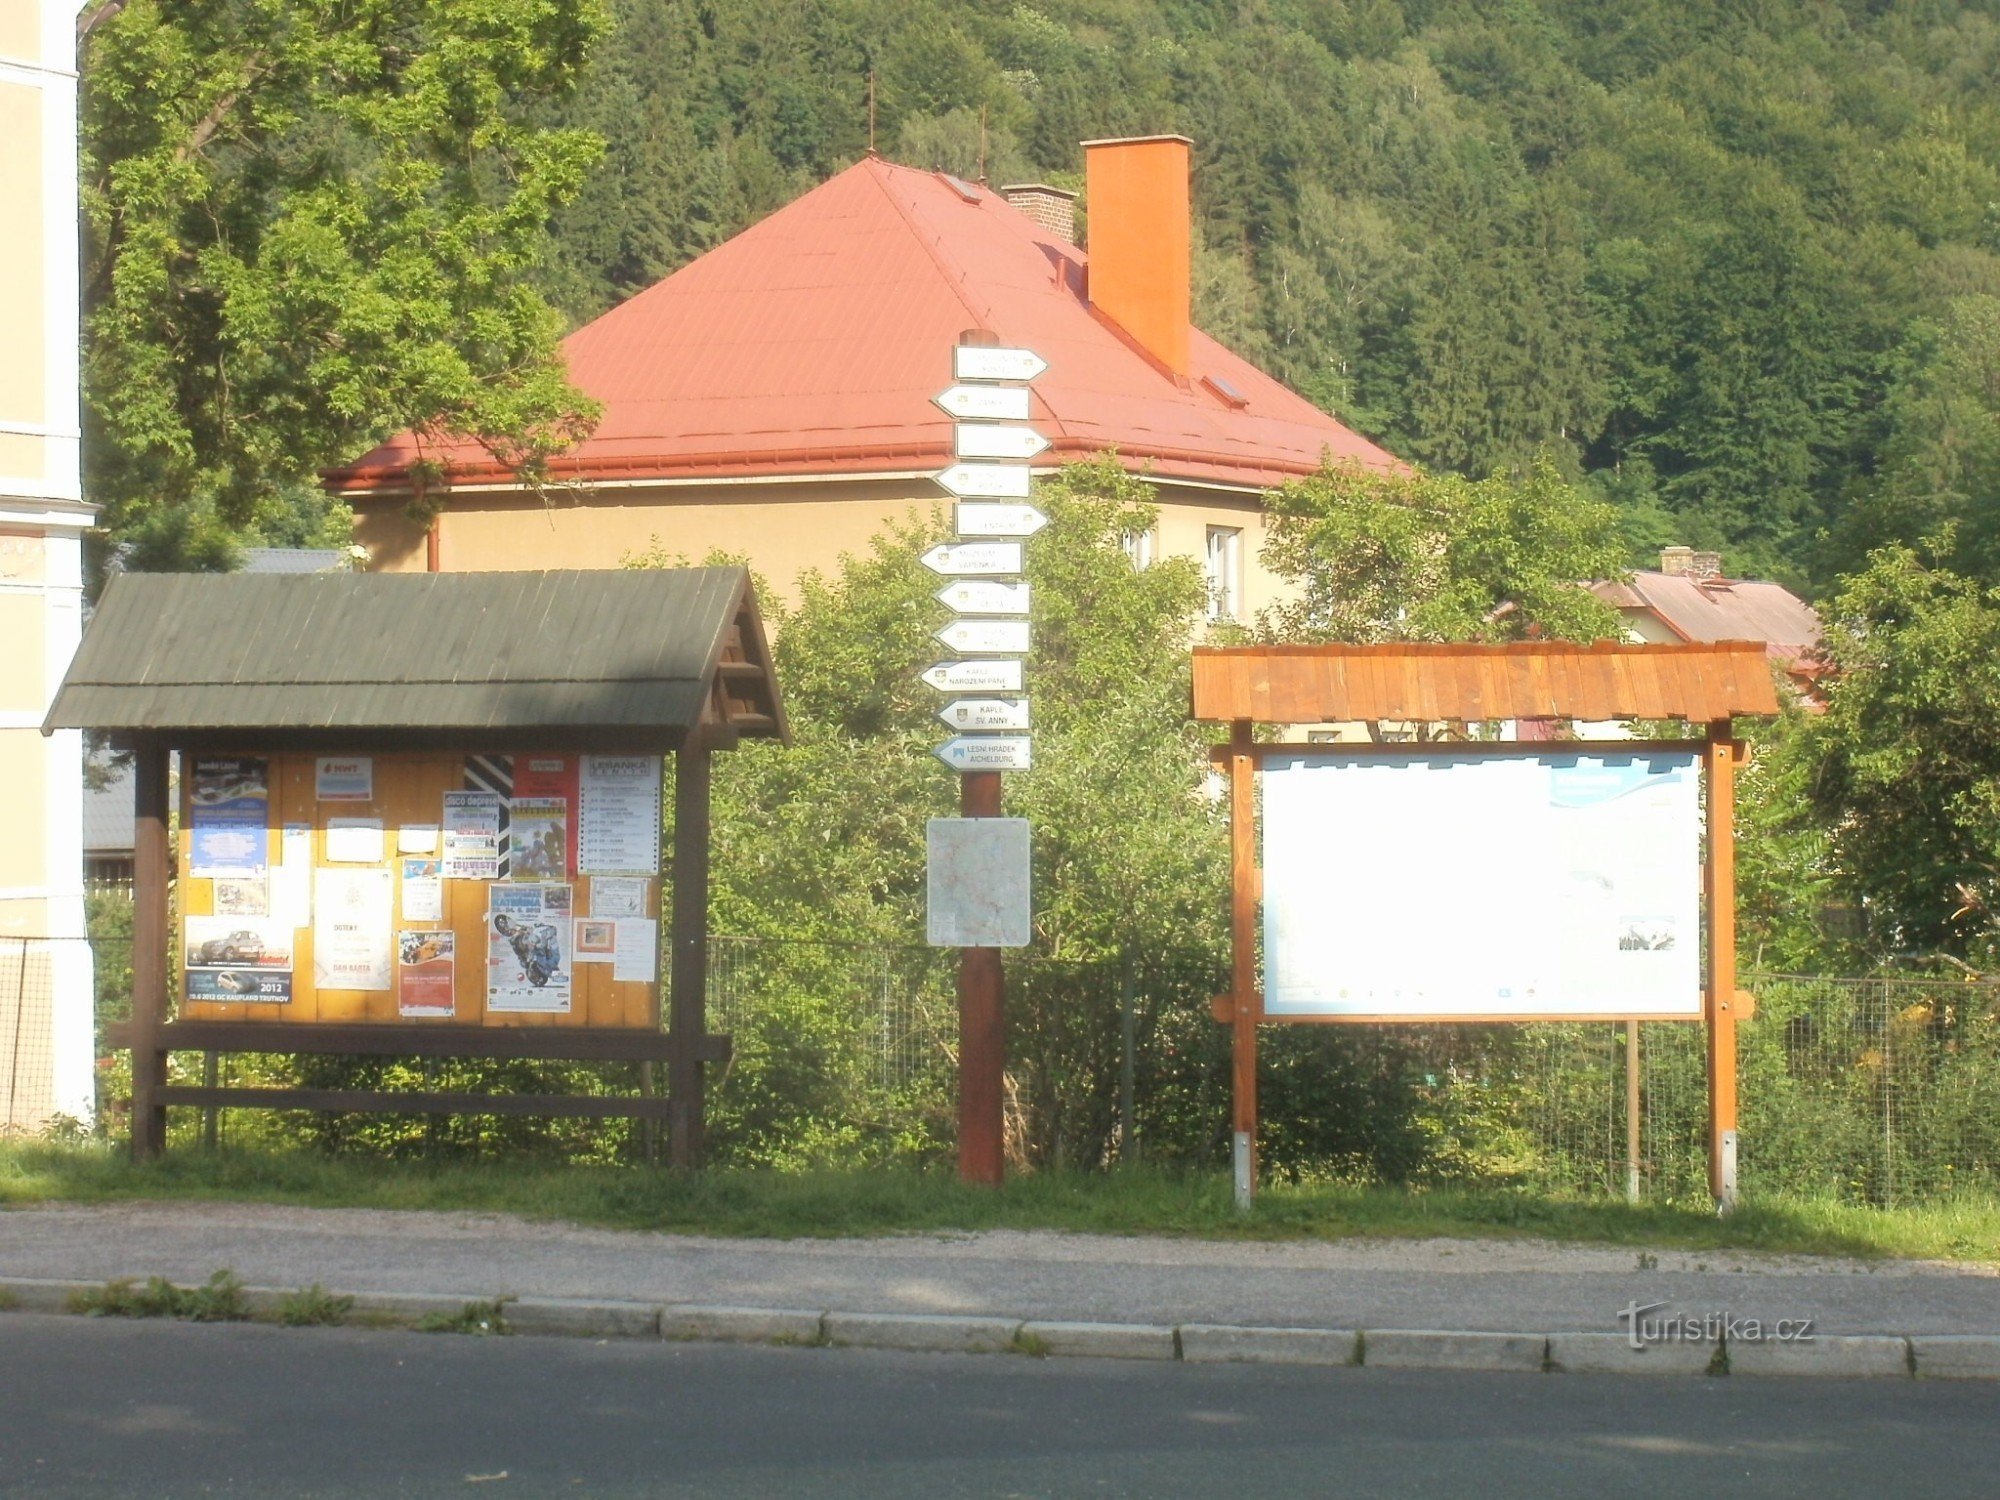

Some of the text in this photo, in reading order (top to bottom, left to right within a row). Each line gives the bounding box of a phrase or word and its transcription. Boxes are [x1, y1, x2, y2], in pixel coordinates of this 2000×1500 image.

[979, 706, 1003, 714] KAPLE
[988, 717, 1008, 725] ANNY
[970, 755, 1014, 763] AICHELBURG
[260, 983, 282, 993] 2012
[202, 993, 216, 1001] 2012
[259, 995, 289, 1003] TRUTNOV
